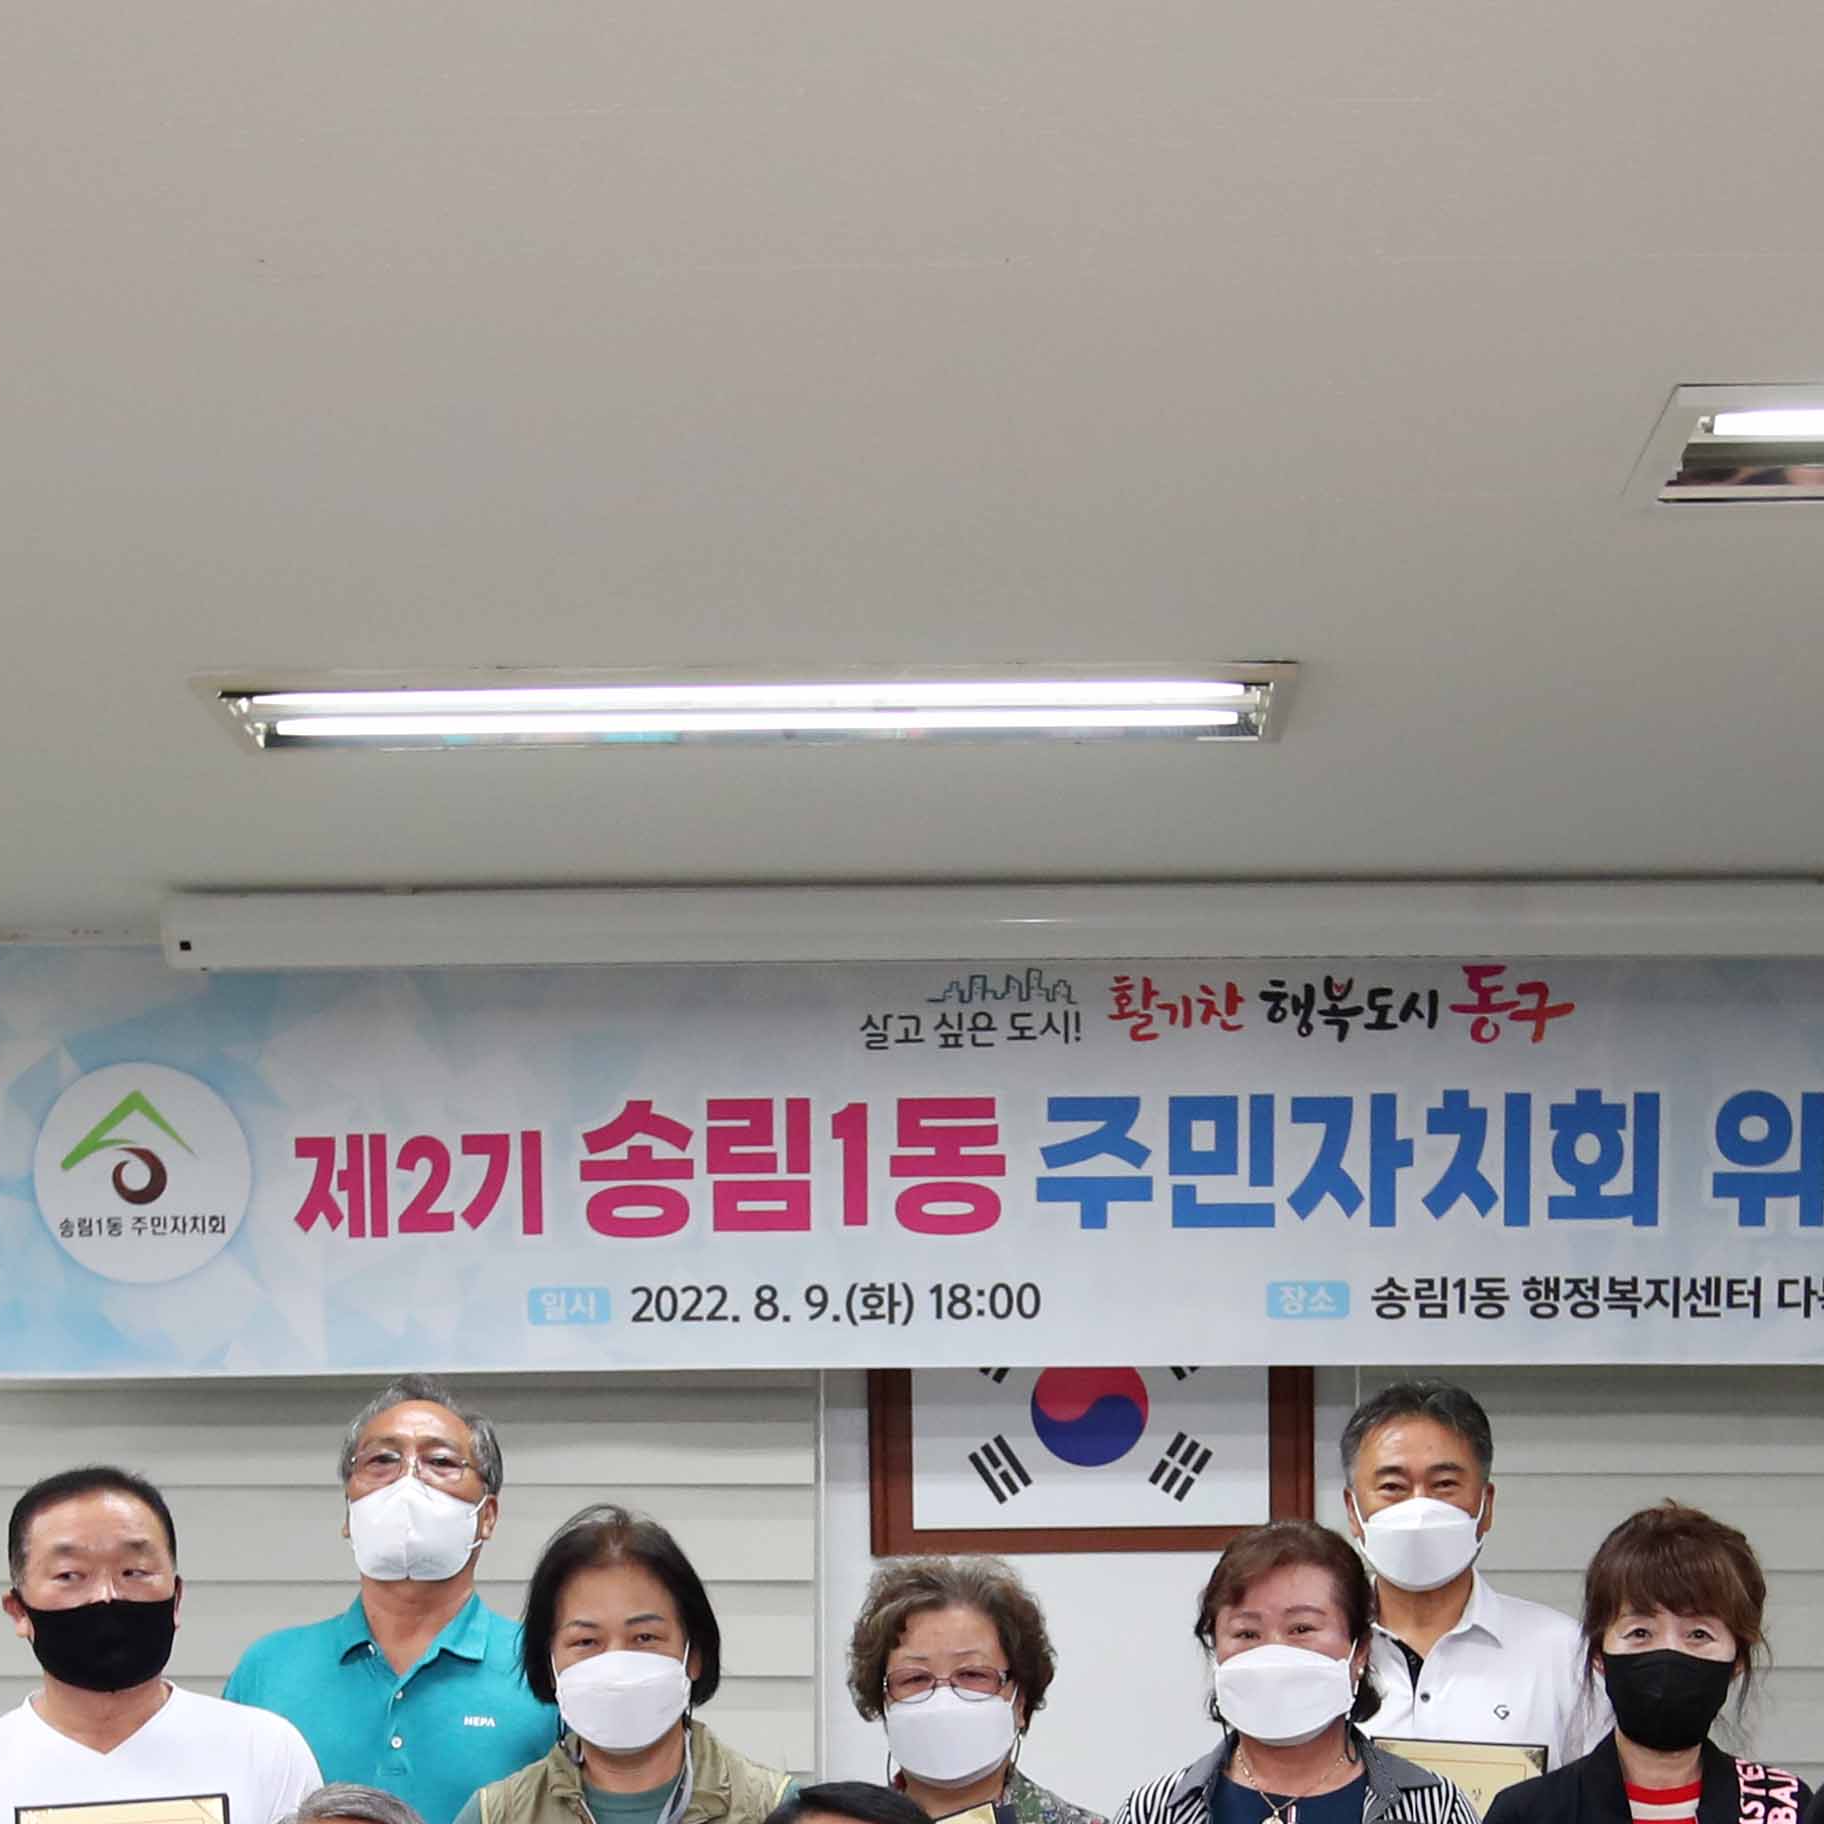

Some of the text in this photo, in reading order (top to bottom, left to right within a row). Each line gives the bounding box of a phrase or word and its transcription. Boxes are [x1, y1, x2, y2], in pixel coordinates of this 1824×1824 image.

[859, 964, 1576, 1051] 살고 싶은 도시! 활기찬 행복도시 동구
[293, 1130, 543, 1239] 제2기
[578, 1096, 1007, 1239] 송림1동
[1035, 1089, 1647, 1230] 주민자치회
[59, 1214, 226, 1238] 송림1동 주민자치회
[630, 1282, 1042, 1327] 2022. 8. 9.(화) 18:00
[1371, 1276, 1511, 1320] 송림1동
[1521, 1276, 1762, 1319] 행정복지센터
